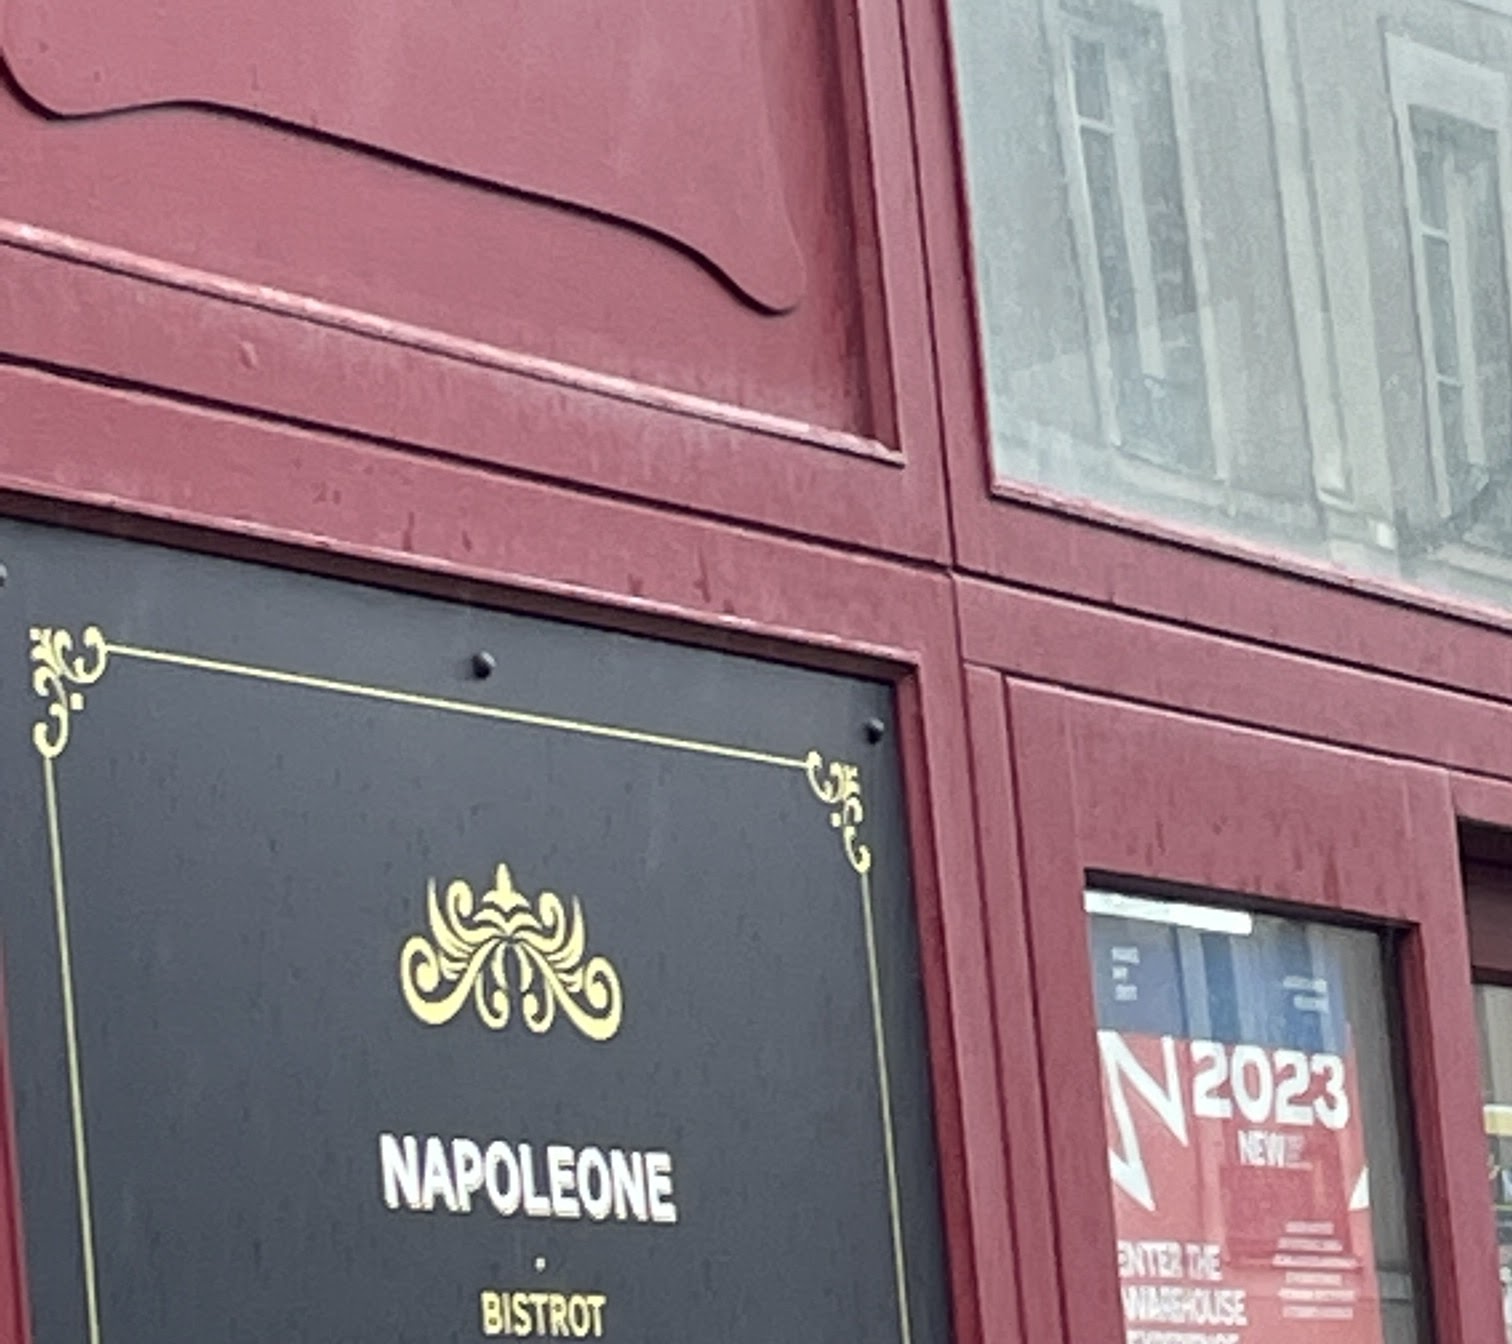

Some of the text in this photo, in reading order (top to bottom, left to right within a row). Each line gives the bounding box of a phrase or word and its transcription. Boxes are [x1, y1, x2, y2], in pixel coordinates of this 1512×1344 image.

[1189, 1039, 1350, 1130] 2023
[380, 1133, 677, 1223] NAPOLEONE
[481, 1290, 606, 1337] BISTROT
